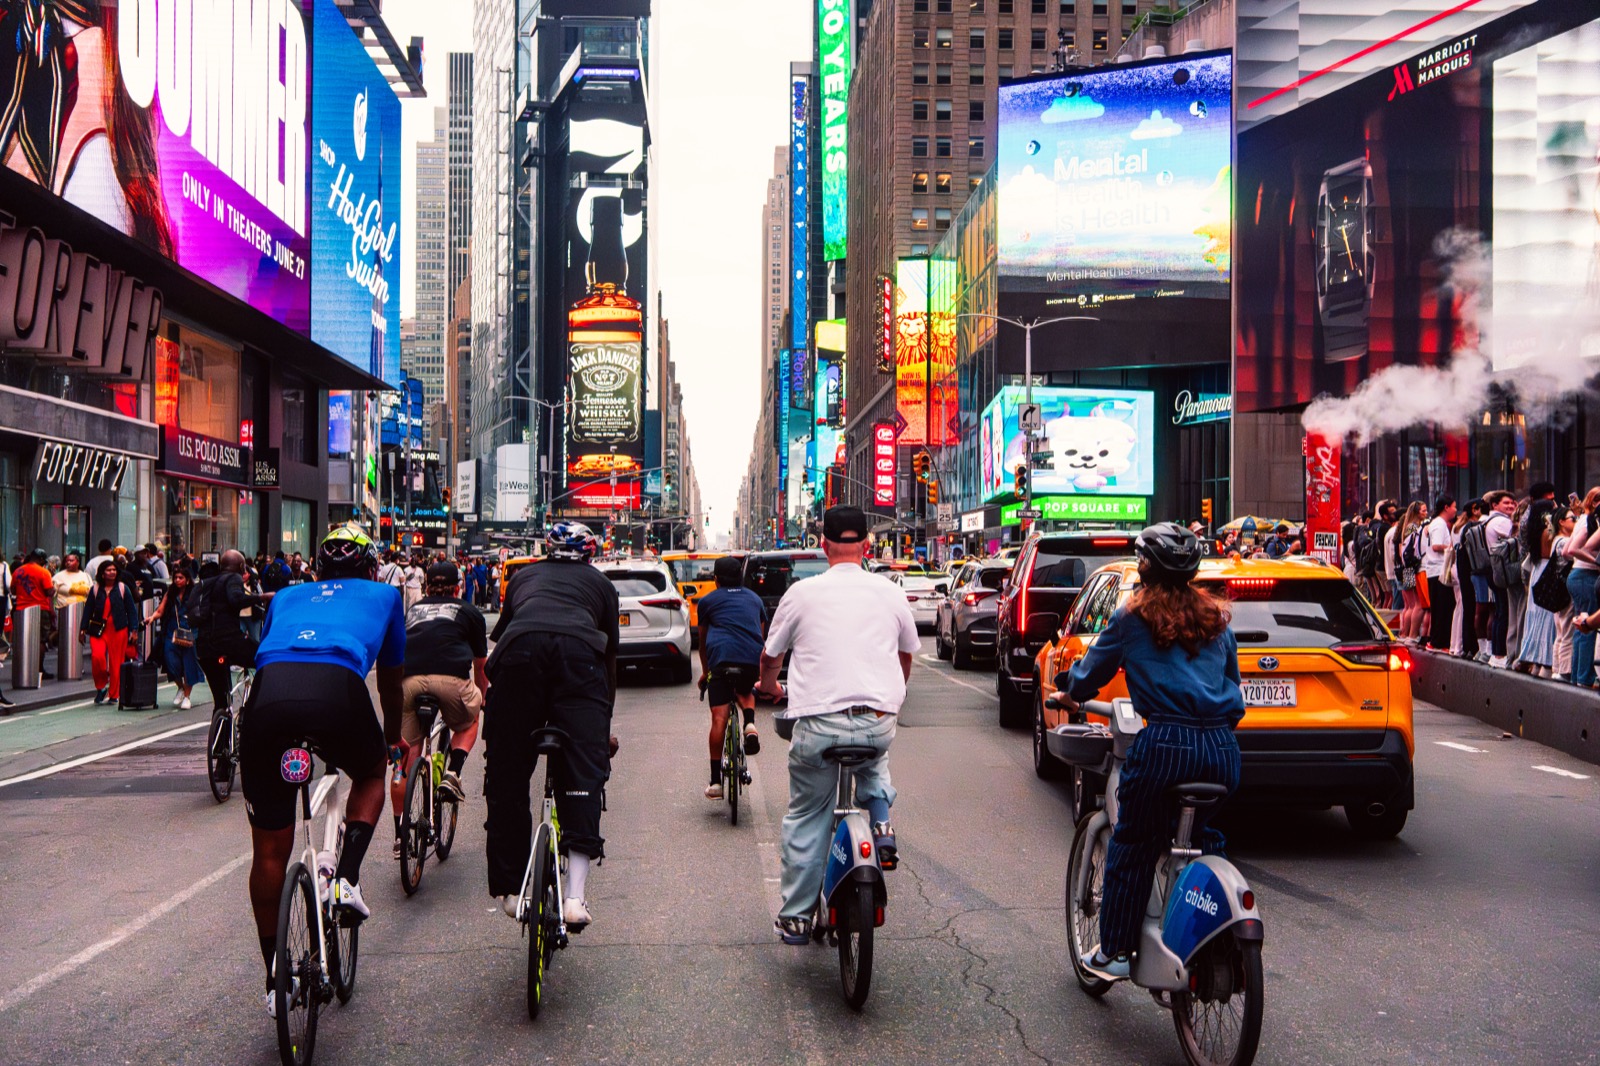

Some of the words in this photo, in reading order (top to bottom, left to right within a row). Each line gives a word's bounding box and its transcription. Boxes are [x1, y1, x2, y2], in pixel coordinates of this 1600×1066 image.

[1419, 34, 1477, 69] MARRIOTT
[1419, 53, 1470, 84] MARQUIS
[823, 42, 848, 173] YEARS
[1054, 148, 1148, 181] Mental
[182, 171, 210, 212] ONLY
[213, 194, 224, 224] IN
[227, 204, 272, 257] THEATERS
[273, 240, 294, 273] JUNE
[295, 257, 305, 280] 27
[328, 163, 366, 233] Hot
[360, 199, 397, 262] Girl
[1081, 201, 1171, 230] Health
[346, 234, 390, 303] Swim
[570, 351, 597, 373] JACK
[597, 347, 640, 374] DANIEL'S
[793, 350, 807, 391] ROKU
[580, 409, 630, 417] WHISKEY
[583, 394, 627, 405] Tennessee
[1172, 389, 1232, 425] Paramoun
[36, 441, 112, 489] FOREVER
[178, 434, 194, 458] U.S.
[195, 439, 218, 463] POLO
[218, 445, 241, 468] ASSN.
[939, 513, 951, 522] 25
[1044, 503, 1068, 513] POP
[1072, 503, 1120, 513] SQUARE
[1127, 503, 1141, 513] BY
[1243, 686, 1291, 700] Y207023C
